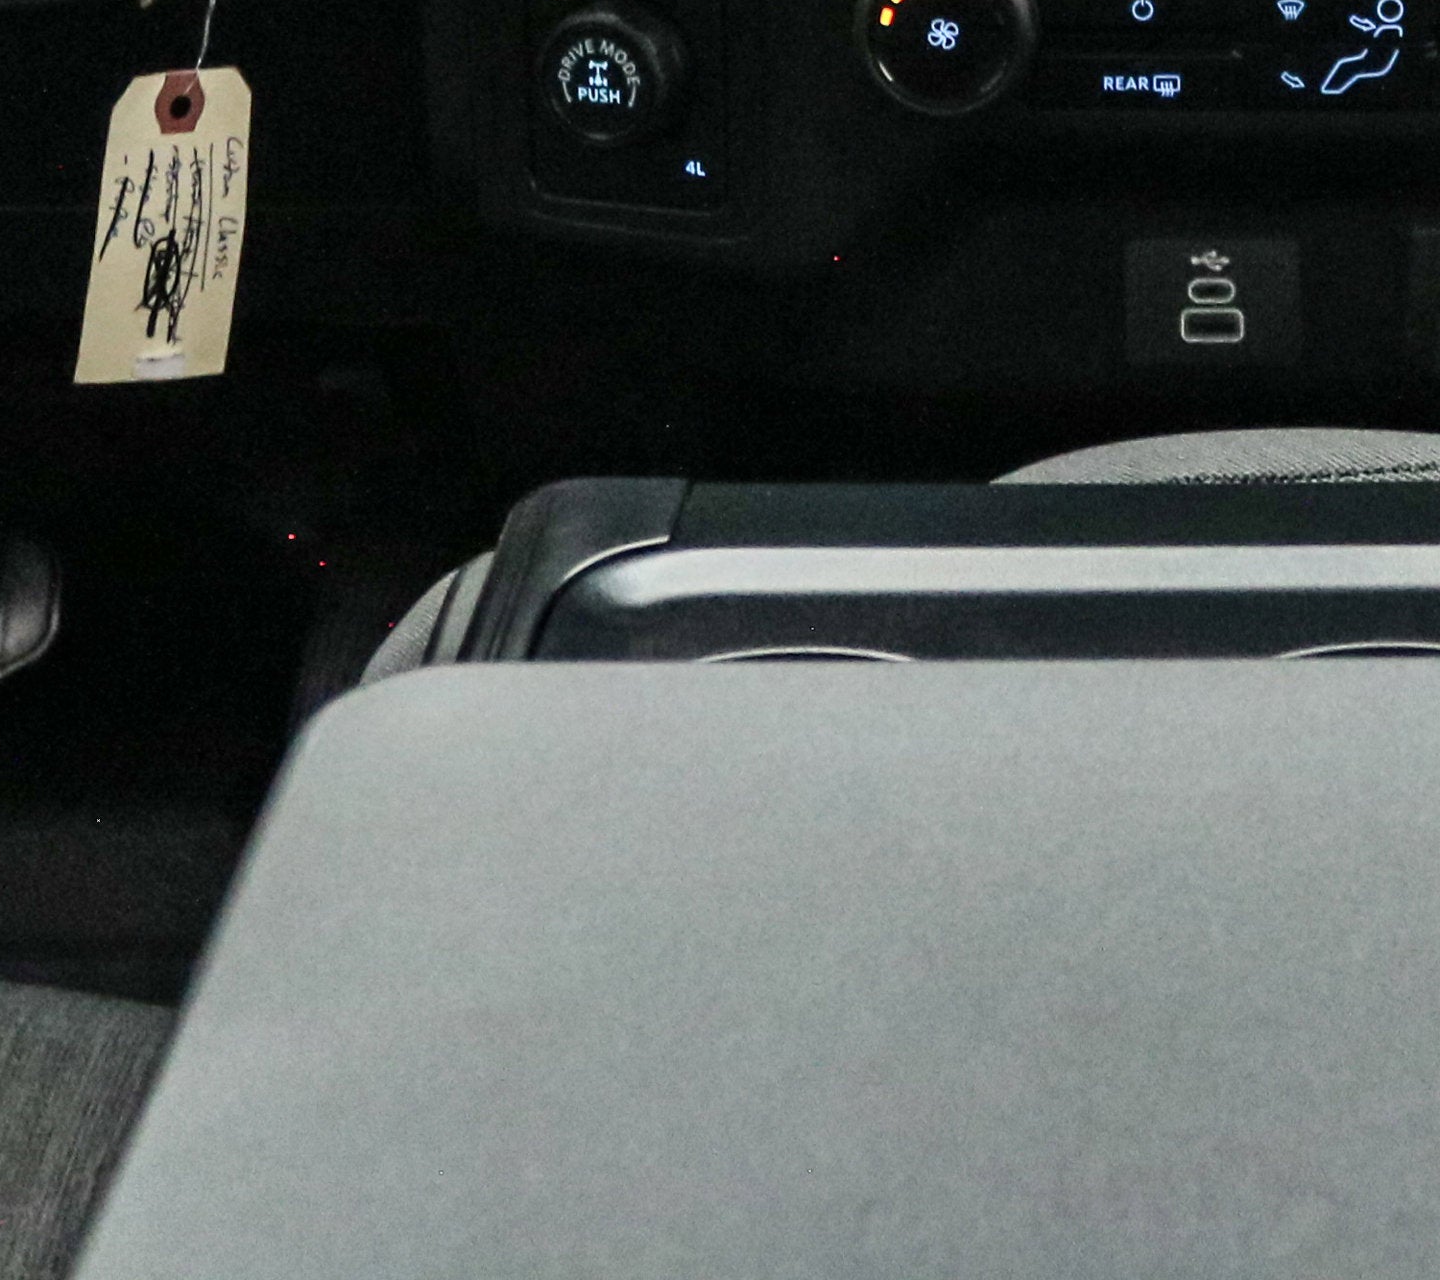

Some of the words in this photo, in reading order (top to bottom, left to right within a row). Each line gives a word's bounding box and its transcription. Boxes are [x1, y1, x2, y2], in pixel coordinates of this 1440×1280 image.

[558, 40, 595, 82] DRIVE
[599, 41, 641, 87] MODE
[1103, 76, 1149, 92] REAR
[577, 88, 621, 104] PUSH
[685, 162, 706, 176] 4L
